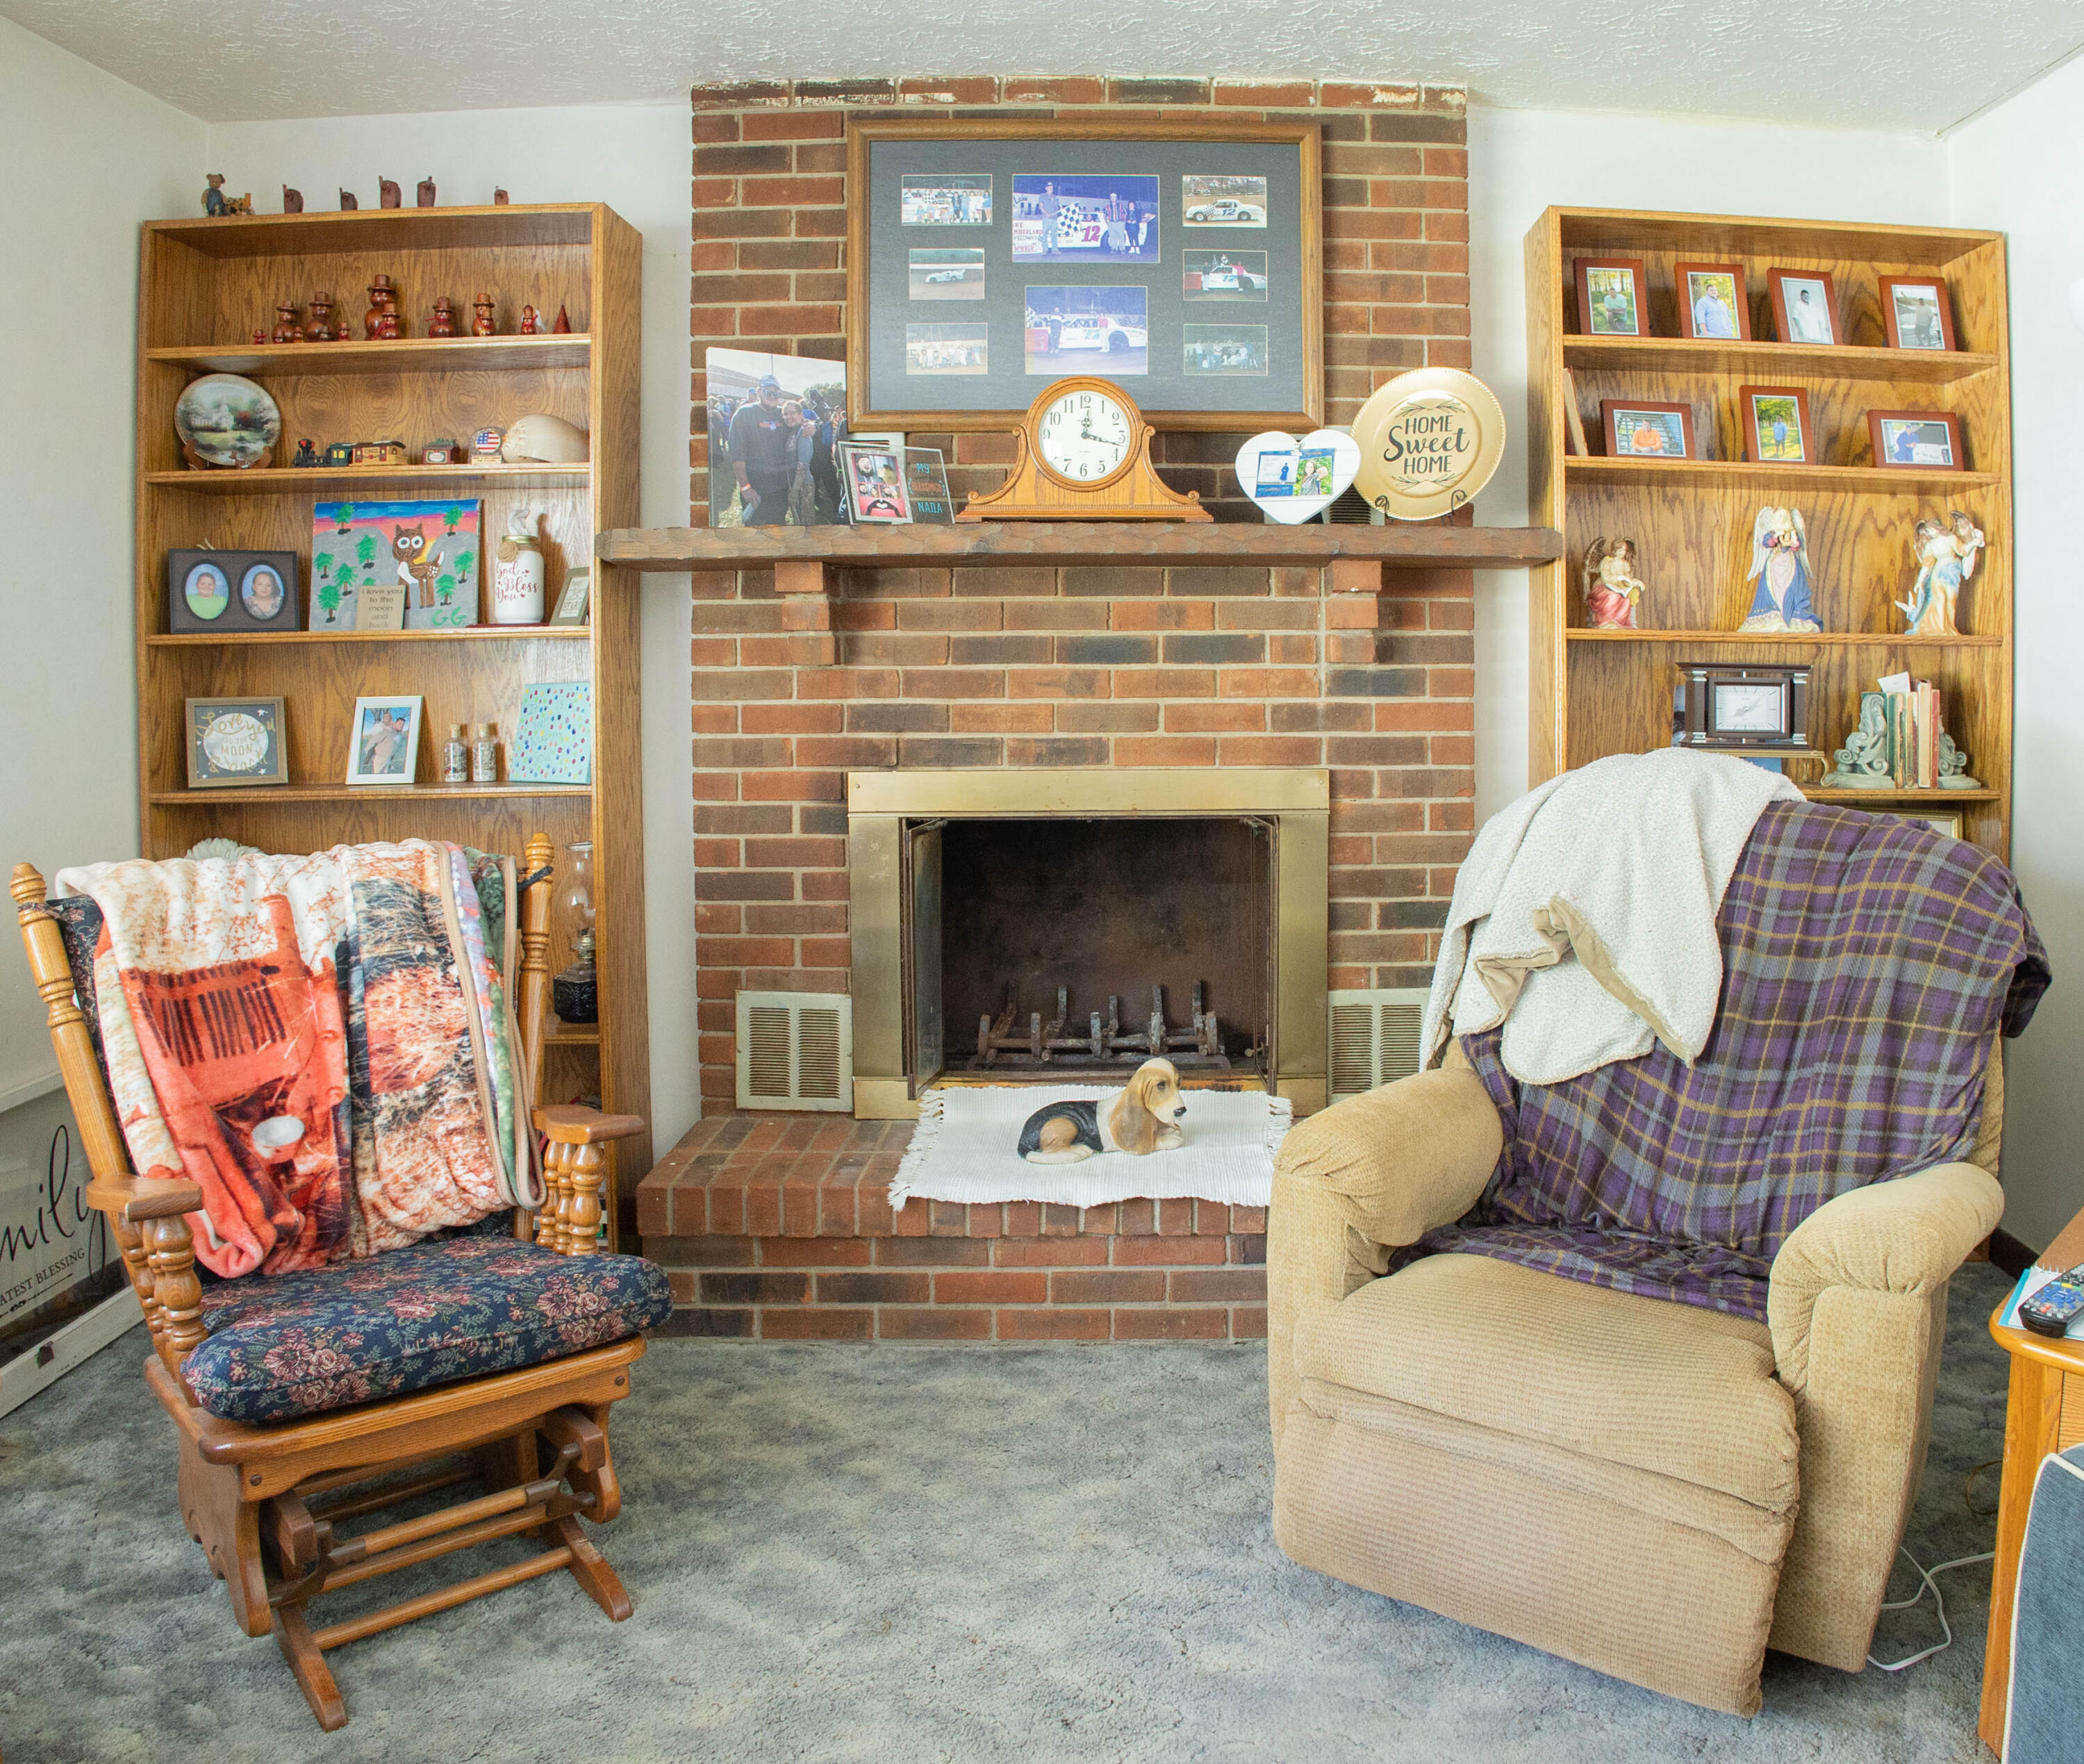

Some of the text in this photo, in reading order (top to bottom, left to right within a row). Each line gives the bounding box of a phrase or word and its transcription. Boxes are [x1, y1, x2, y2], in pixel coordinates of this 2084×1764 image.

[1082, 225, 1101, 242] 12
[1064, 399, 1073, 414] 11
[1080, 395, 1091, 409] 12
[1101, 399, 1105, 414] 1
[1050, 411, 1061, 426] 10
[1111, 411, 1120, 425] 2
[1405, 415, 1453, 434] HOME
[1043, 428, 1050, 439] 9
[1118, 429, 1126, 443] 3
[1384, 425, 1470, 462] Sweet
[1111, 447, 1120, 461] 4
[916, 463, 930, 474] MY
[1064, 459, 1072, 472] 7
[1080, 463, 1087, 477] 6
[1098, 459, 1105, 473] 5
[1403, 455, 1453, 475] HOME
[496, 561, 520, 579] God
[504, 577, 539, 593] Bless
[497, 587, 518, 603] You
[195, 711, 276, 741] Love you
[220, 743, 253, 757] MOON
[35, 1247, 85, 1285] BLESSING
